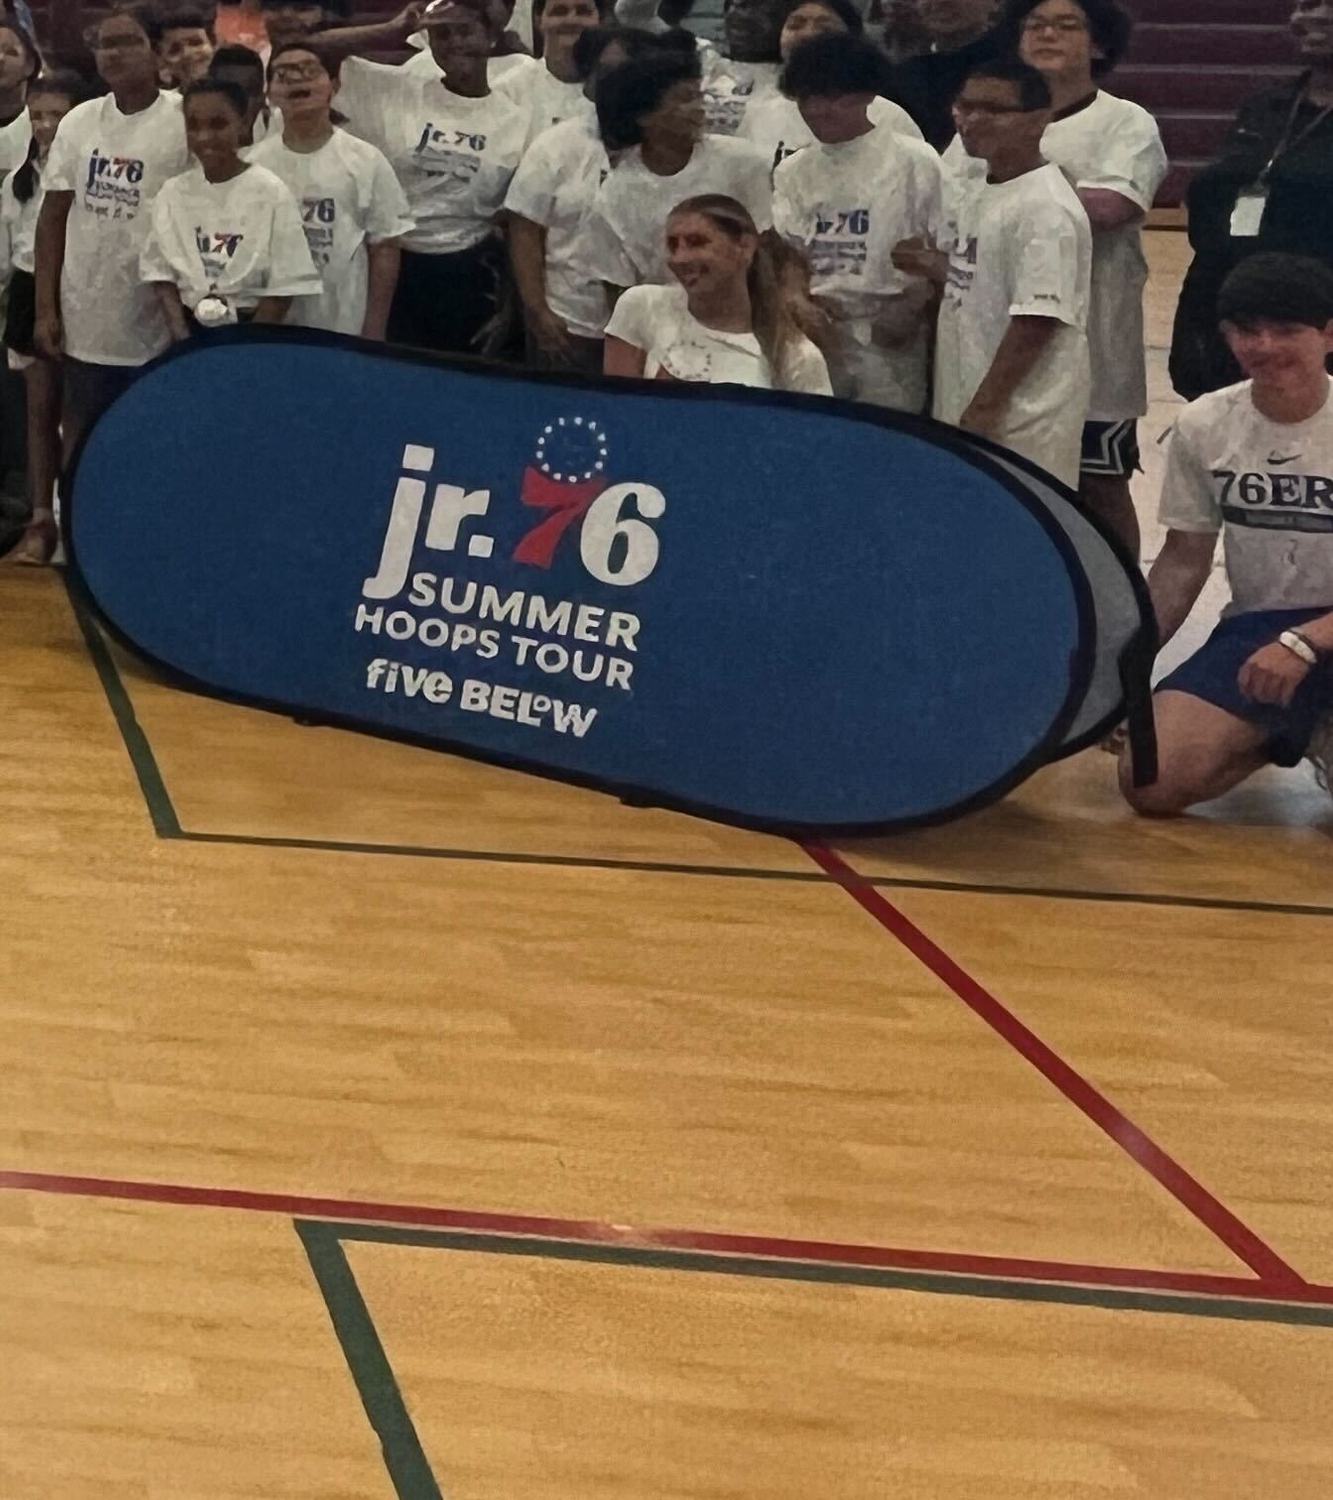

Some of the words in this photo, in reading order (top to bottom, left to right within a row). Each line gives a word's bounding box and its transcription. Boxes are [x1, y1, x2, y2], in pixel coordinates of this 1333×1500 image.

[362, 444, 495, 599] jr.
[511, 466, 667, 587] 76
[353, 603, 501, 659] HOOPS
[510, 634, 635, 690] TOUR
[407, 571, 642, 652] SUMMER
[365, 657, 454, 704] five
